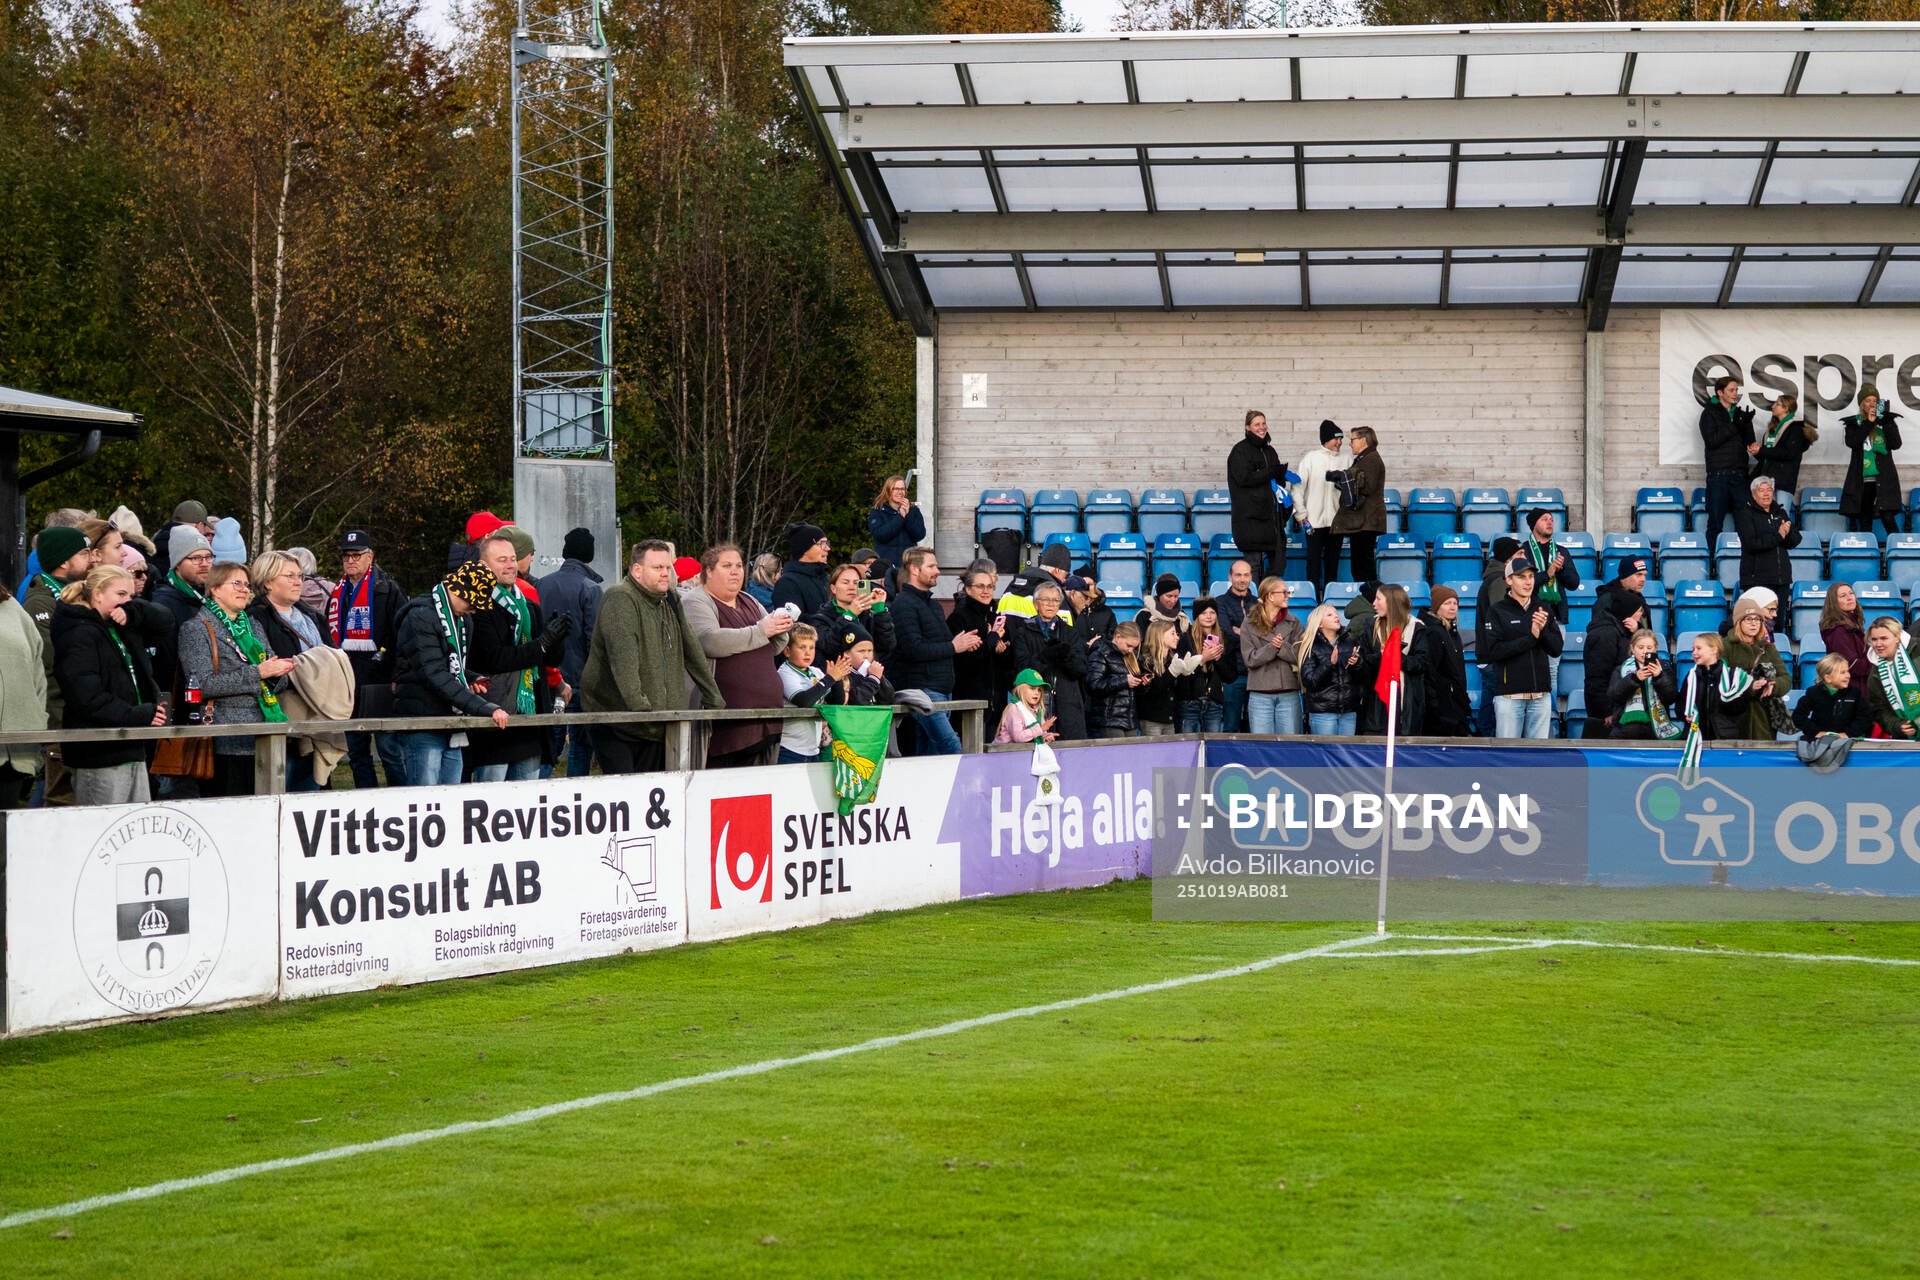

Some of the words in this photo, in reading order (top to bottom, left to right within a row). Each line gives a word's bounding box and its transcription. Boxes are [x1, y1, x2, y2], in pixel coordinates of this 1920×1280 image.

[98, 815, 207, 865] STIFTELSEN
[292, 803, 446, 862] Vittsjö
[463, 793, 630, 845] Revision
[645, 788, 672, 829] &
[784, 806, 911, 852] SVENSKA
[991, 785, 1084, 868] Heja
[1330, 790, 1543, 856] OBOS
[296, 867, 470, 929] Konsult
[483, 860, 542, 909] AB
[784, 857, 852, 900] SPEL
[434, 922, 517, 944] Bolagsbildning
[580, 904, 667, 925] Företagsvärdering
[580, 920, 678, 942] Företagsöverlåtelser
[286, 941, 363, 962] Redovisning
[286, 956, 389, 980] Skatterådgivning
[435, 942, 496, 961] Ekonomisk
[499, 934, 554, 954] rådgivning
[96, 954, 212, 1010] VITTSJÖFONDEN
